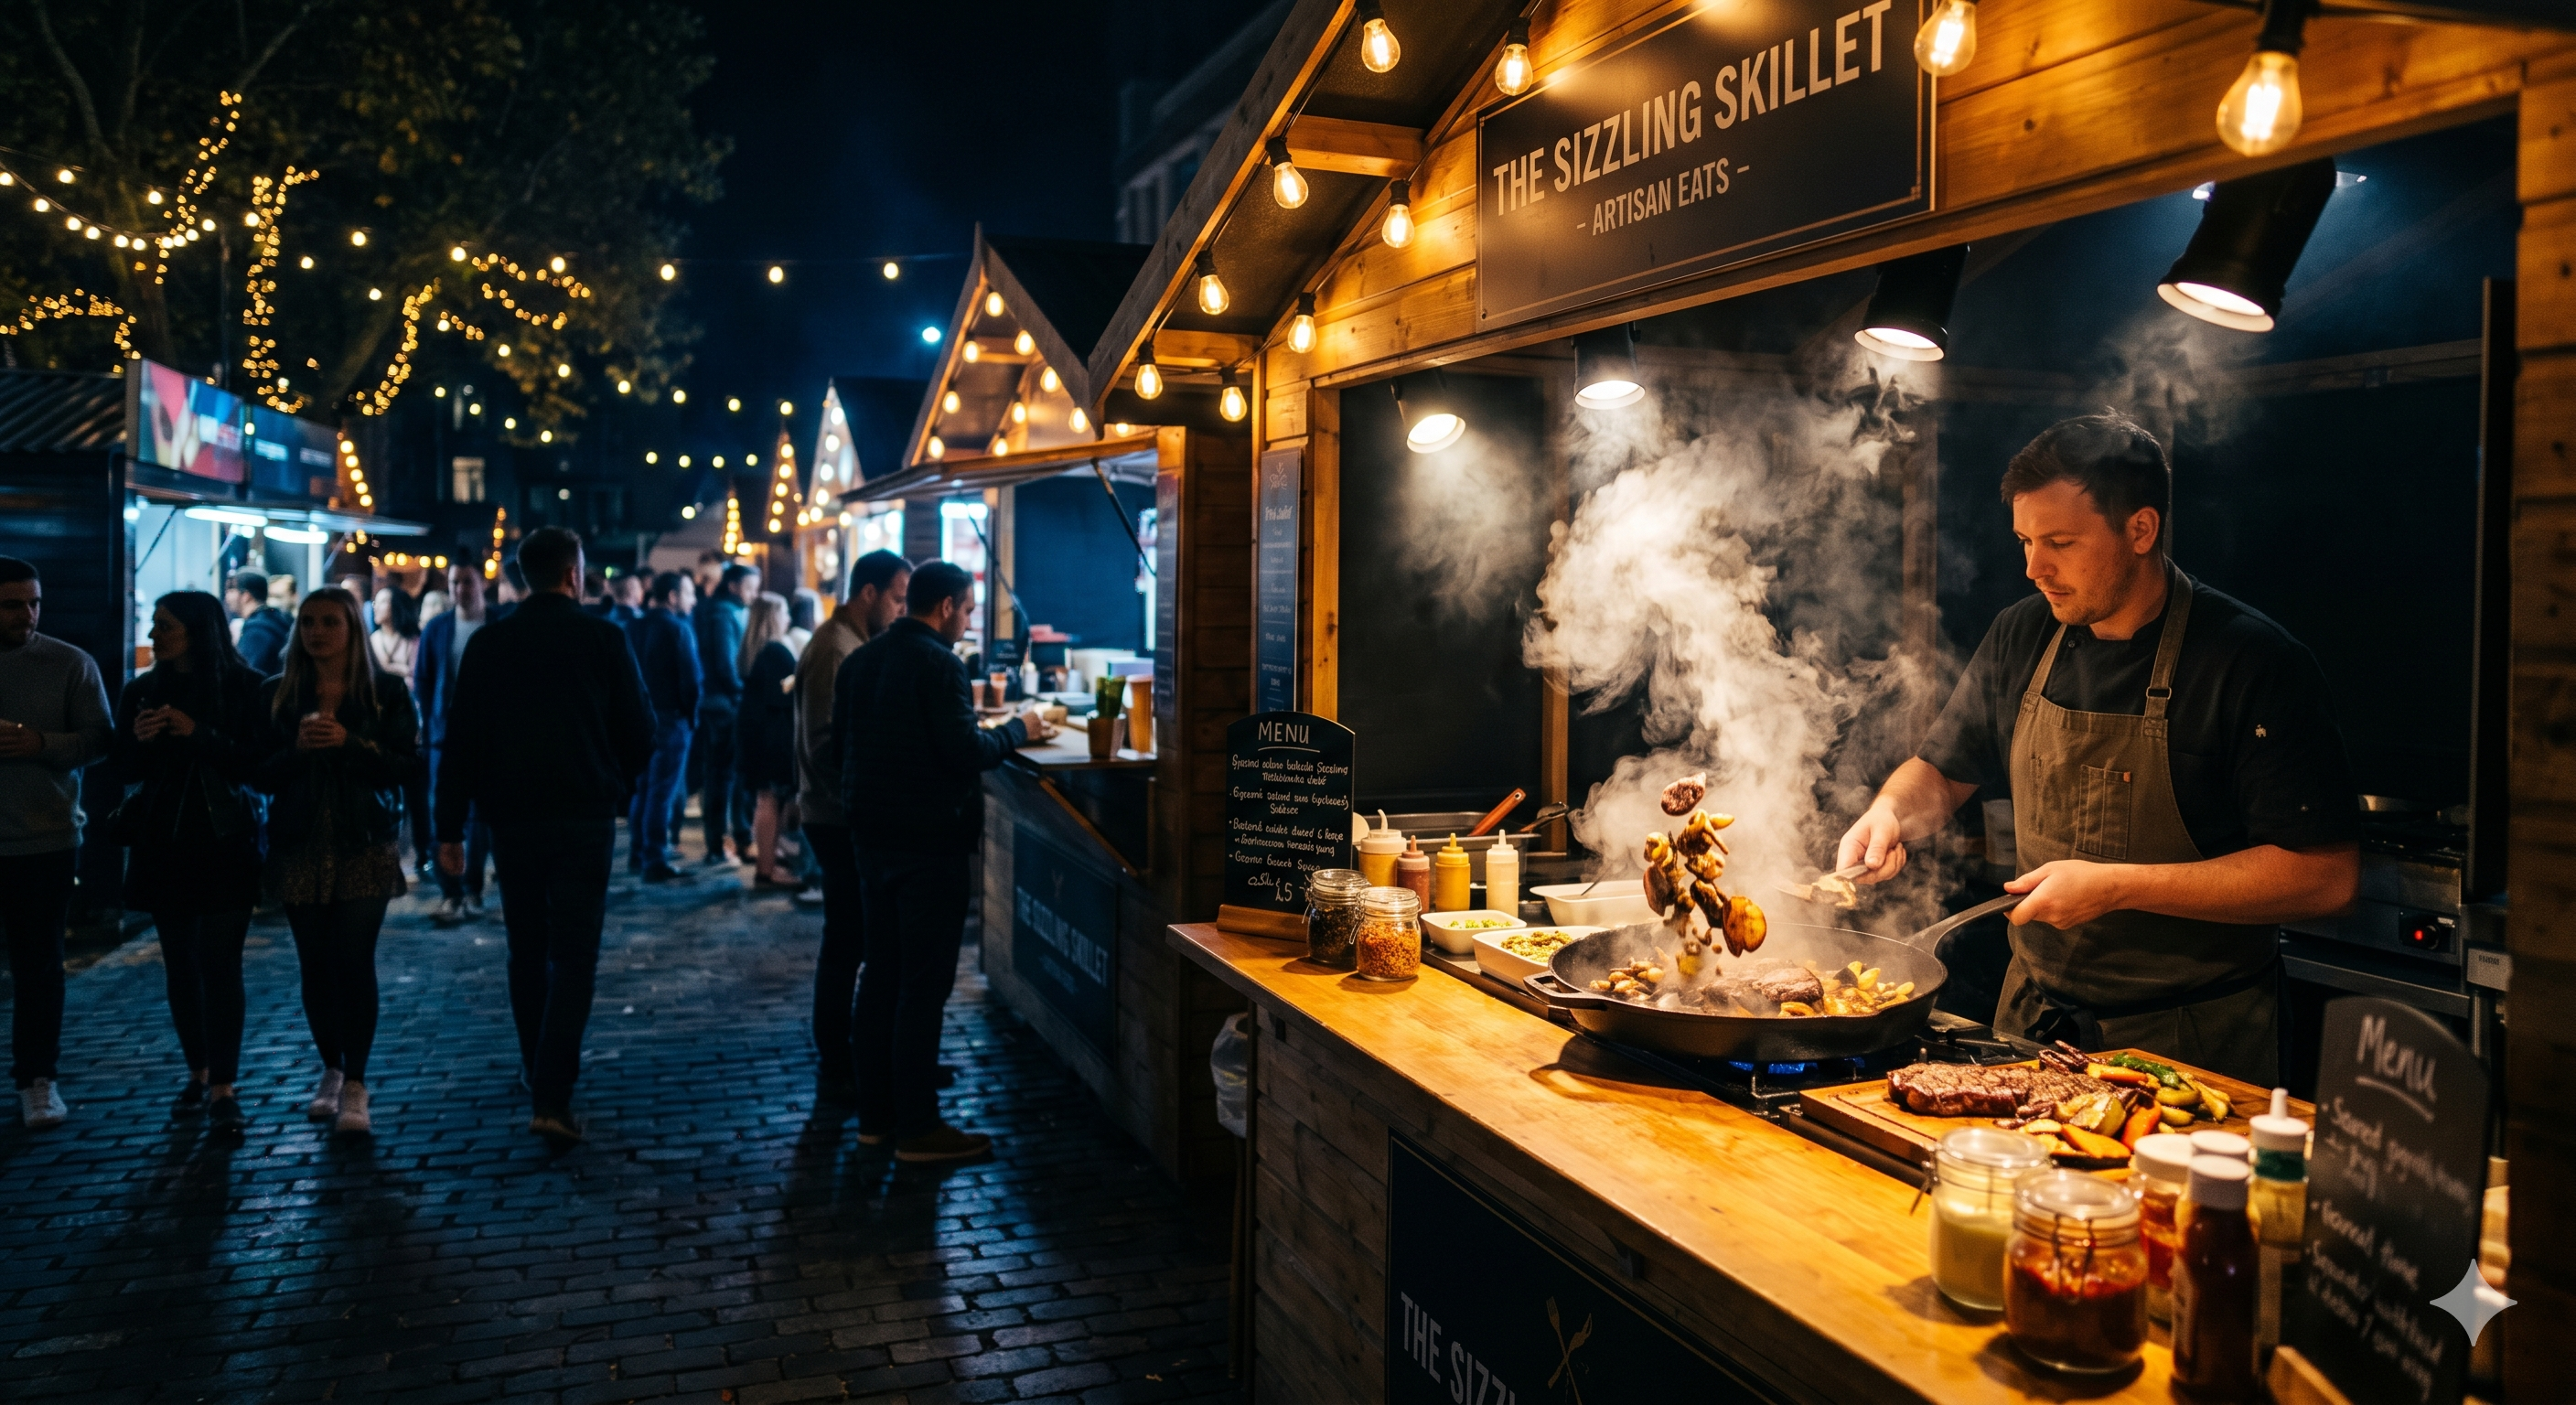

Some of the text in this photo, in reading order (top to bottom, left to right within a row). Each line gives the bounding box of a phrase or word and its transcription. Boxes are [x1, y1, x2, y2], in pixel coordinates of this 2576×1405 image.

[1493, 1, 1892, 215] THE SIZZLING SKILLET
[1593, 178, 1670, 236] ARTISAN
[1678, 157, 1730, 207] EATS
[1258, 721, 1310, 745] MENU
[2356, 1014, 2438, 1102] Menu
[1401, 1291, 1442, 1385] THE
